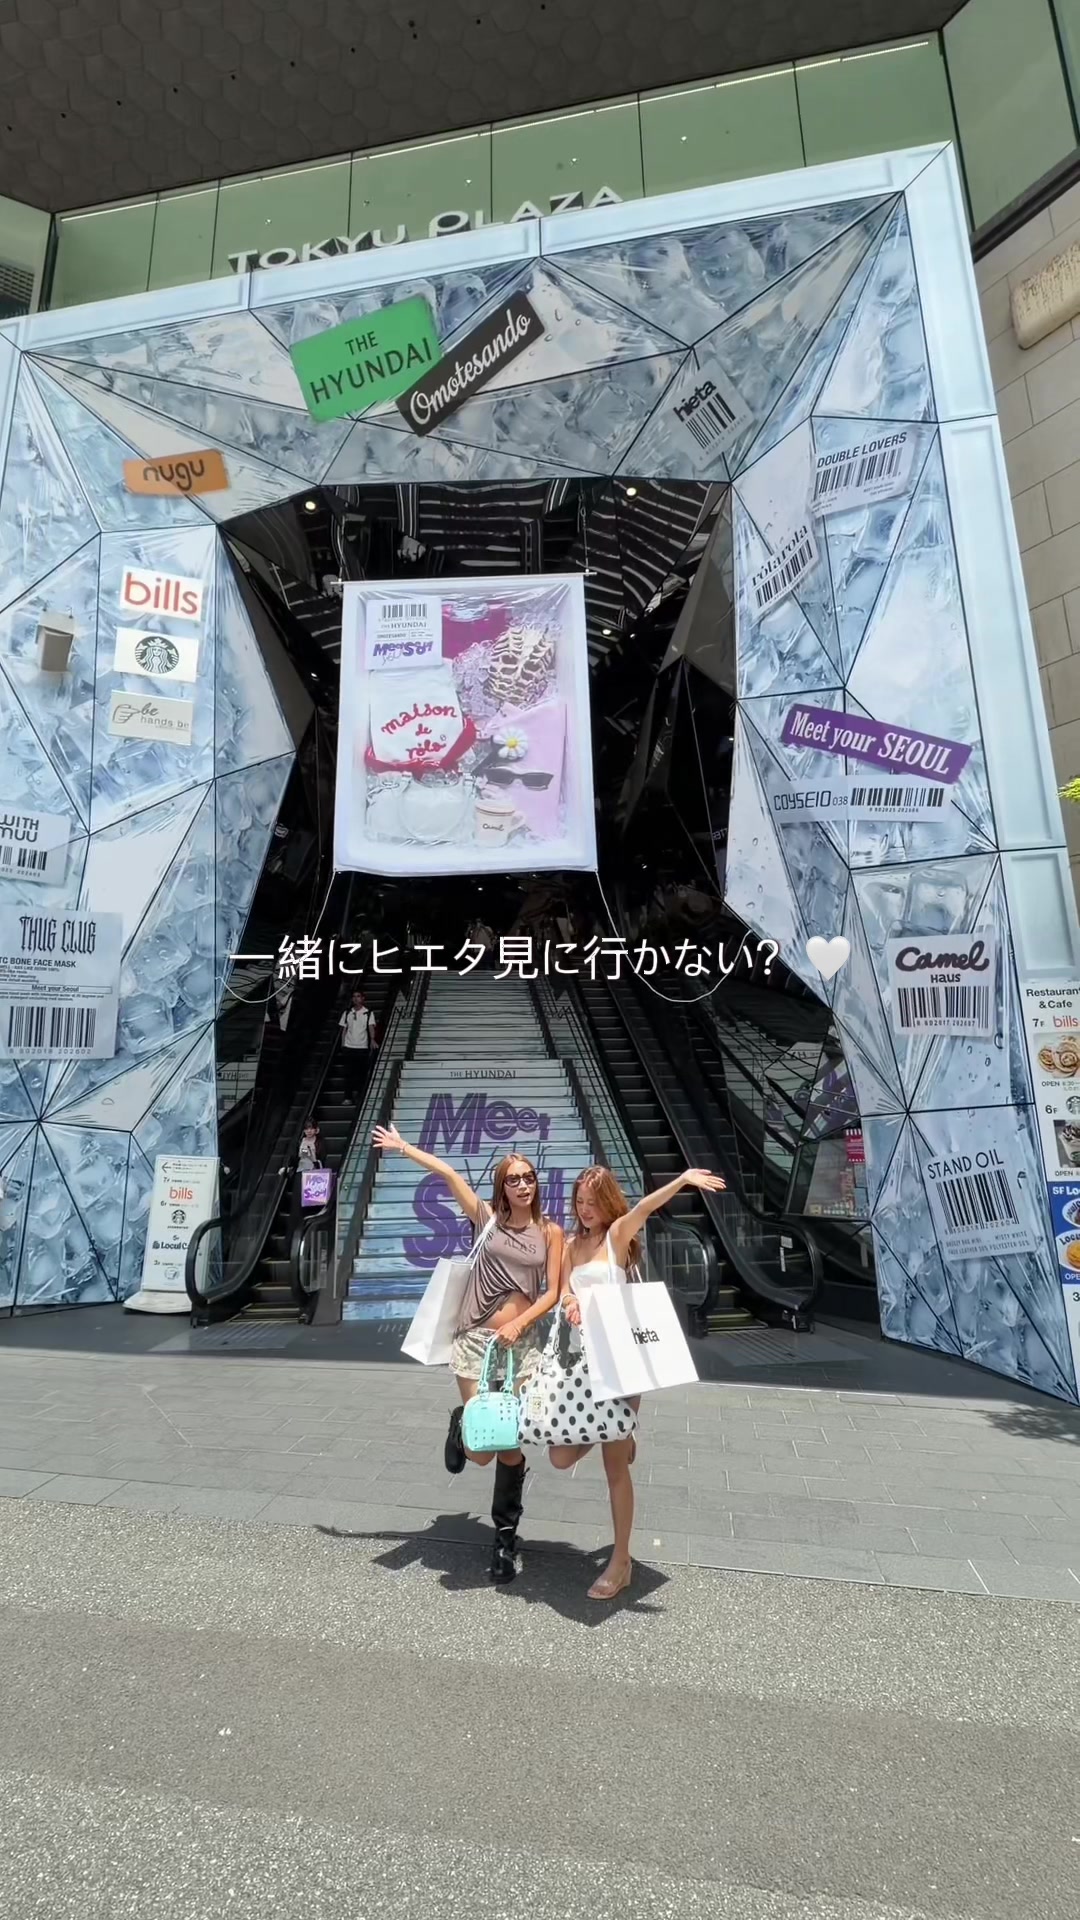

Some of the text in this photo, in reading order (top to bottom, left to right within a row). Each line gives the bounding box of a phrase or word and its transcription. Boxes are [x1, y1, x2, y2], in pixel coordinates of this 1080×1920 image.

[228, 186, 625, 274] TOKYU PLAZA
[344, 330, 379, 357] THE
[308, 337, 434, 404] HYUNDAI
[408, 310, 531, 426] Omotesando
[673, 380, 717, 422] hieta
[817, 432, 907, 468] DOUBLE LOVERS
[143, 459, 205, 491] nugu
[124, 571, 198, 615] bills
[140, 716, 174, 728] hands
[177, 720, 190, 729] be
[141, 702, 159, 716] be
[381, 703, 457, 735] maison
[790, 710, 952, 774] Meet your SEOUL
[832, 796, 848, 806] 038
[0, 814, 39, 831] WITH
[19, 915, 96, 955] THUG CLUB
[10, 957, 31, 966] BONE
[33, 959, 52, 967] FACE
[54, 960, 76, 968] MASK
[895, 940, 990, 972] Camel
[1026, 988, 1080, 997] Restauran
[1053, 1015, 1079, 1027] bills
[465, 1070, 516, 1079] HYUNDAI
[927, 1148, 1004, 1180] STAND OIL
[169, 1186, 193, 1199] bills
[1052, 1186, 1080, 1195] SF Lo
[630, 1327, 660, 1344] hieta
